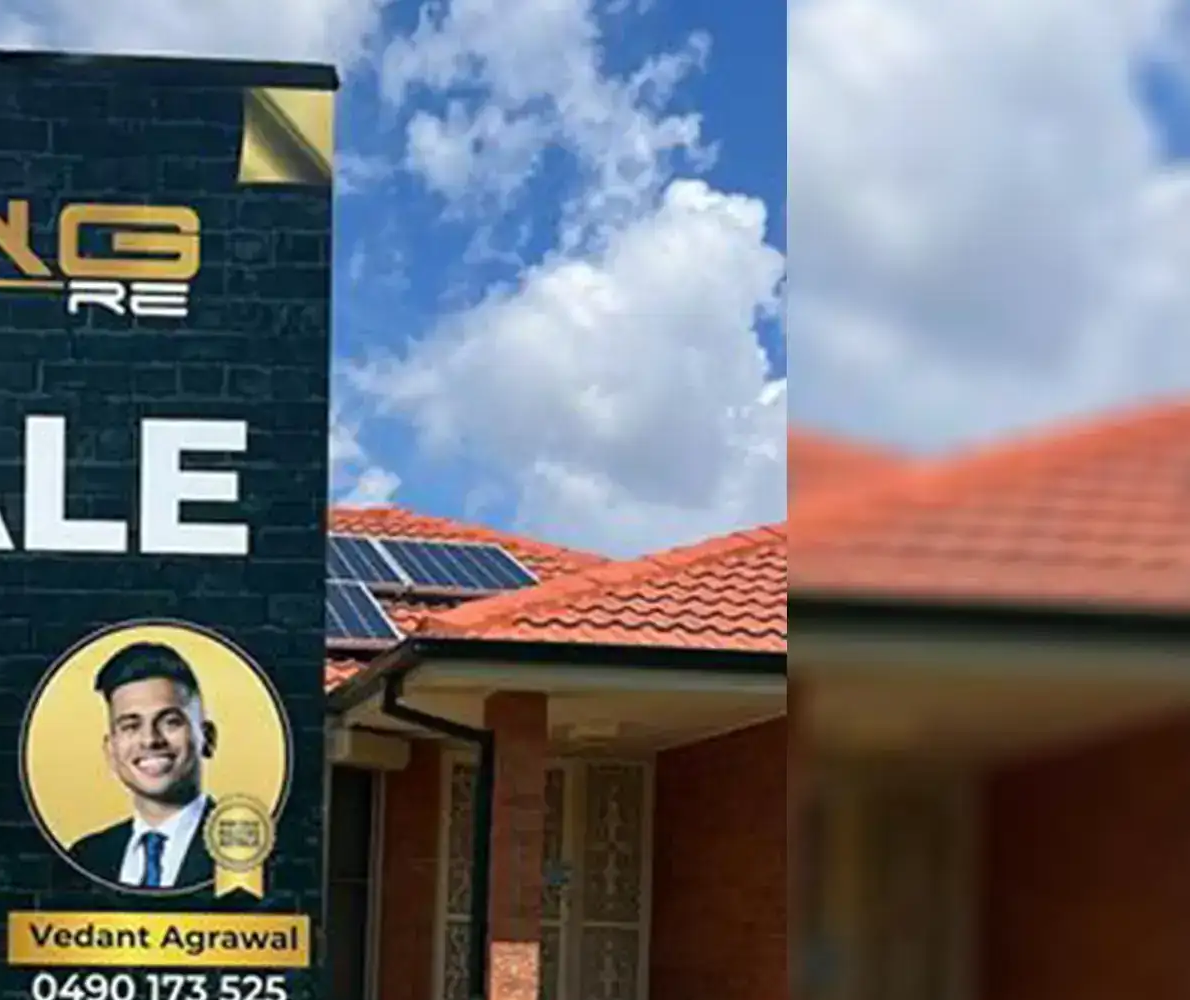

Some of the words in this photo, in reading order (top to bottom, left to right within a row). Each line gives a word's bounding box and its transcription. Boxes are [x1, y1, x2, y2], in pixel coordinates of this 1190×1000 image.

[67, 280, 191, 318] RE
[30, 923, 150, 948] Vedant
[161, 925, 298, 954] Agrawal
